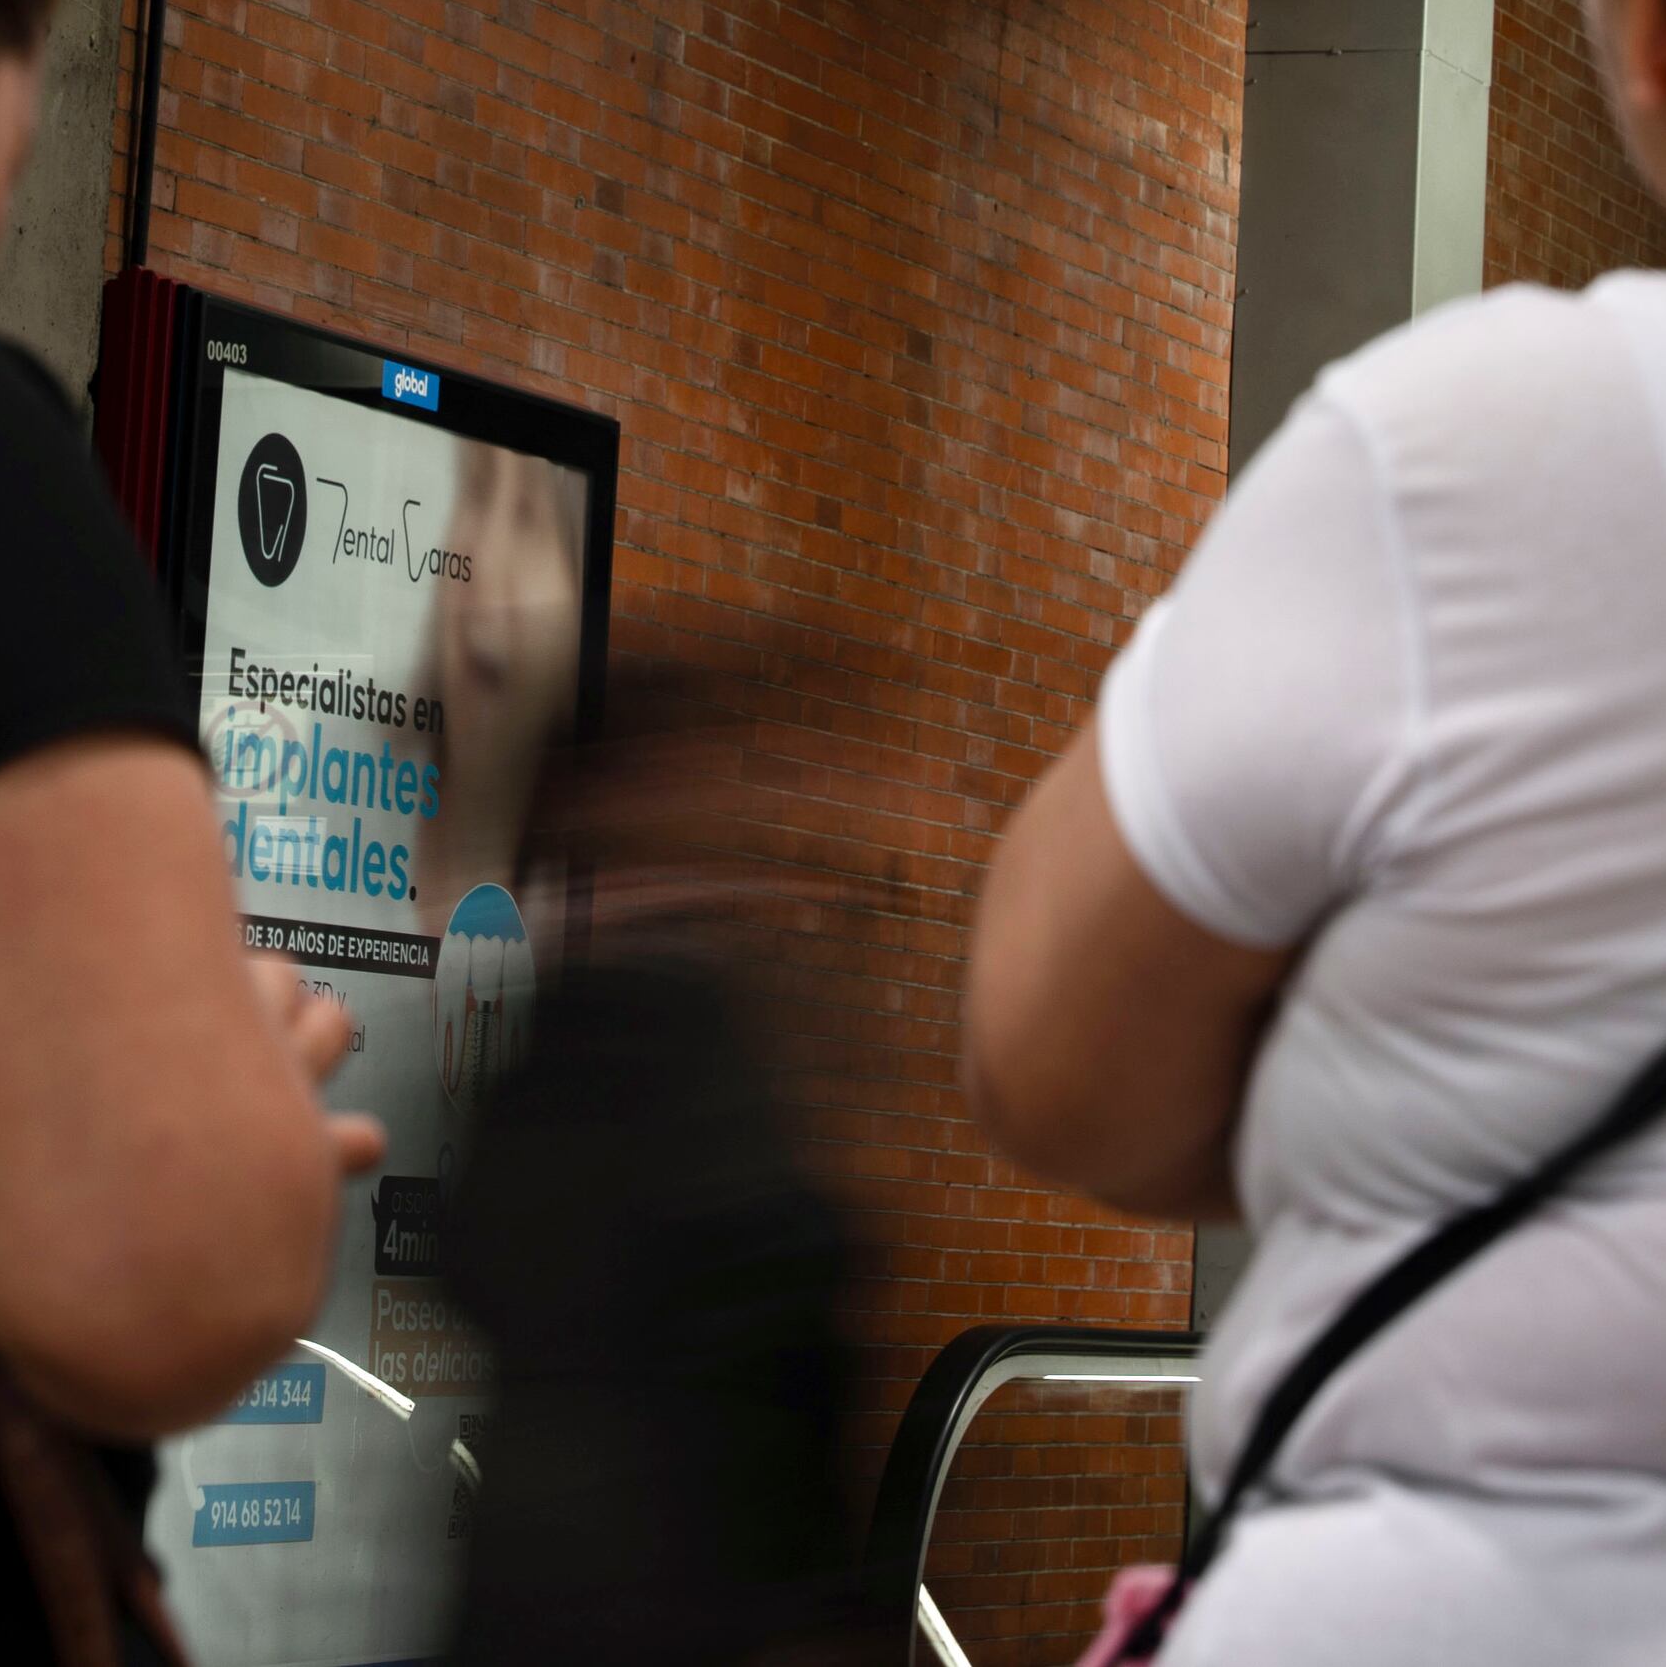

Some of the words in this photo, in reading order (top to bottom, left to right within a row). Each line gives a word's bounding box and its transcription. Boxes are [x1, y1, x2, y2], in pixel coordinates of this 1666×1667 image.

[207, 339, 247, 364] 00403
[395, 368, 428, 398] global
[228, 648, 406, 731] Especialistas
[414, 698, 444, 735] en
[223, 705, 440, 820] implantes
[246, 924, 263, 947] DE
[266, 926, 284, 950] 30
[287, 926, 324, 954] AÑOS
[328, 934, 344, 957] DE
[348, 937, 430, 967] EXPERIENCIA
[376, 1288, 447, 1331] Paseo
[250, 1380, 277, 1407] 314
[281, 1380, 311, 1407] 344
[211, 1499, 237, 1530] 914
[241, 1499, 261, 1528] 68
